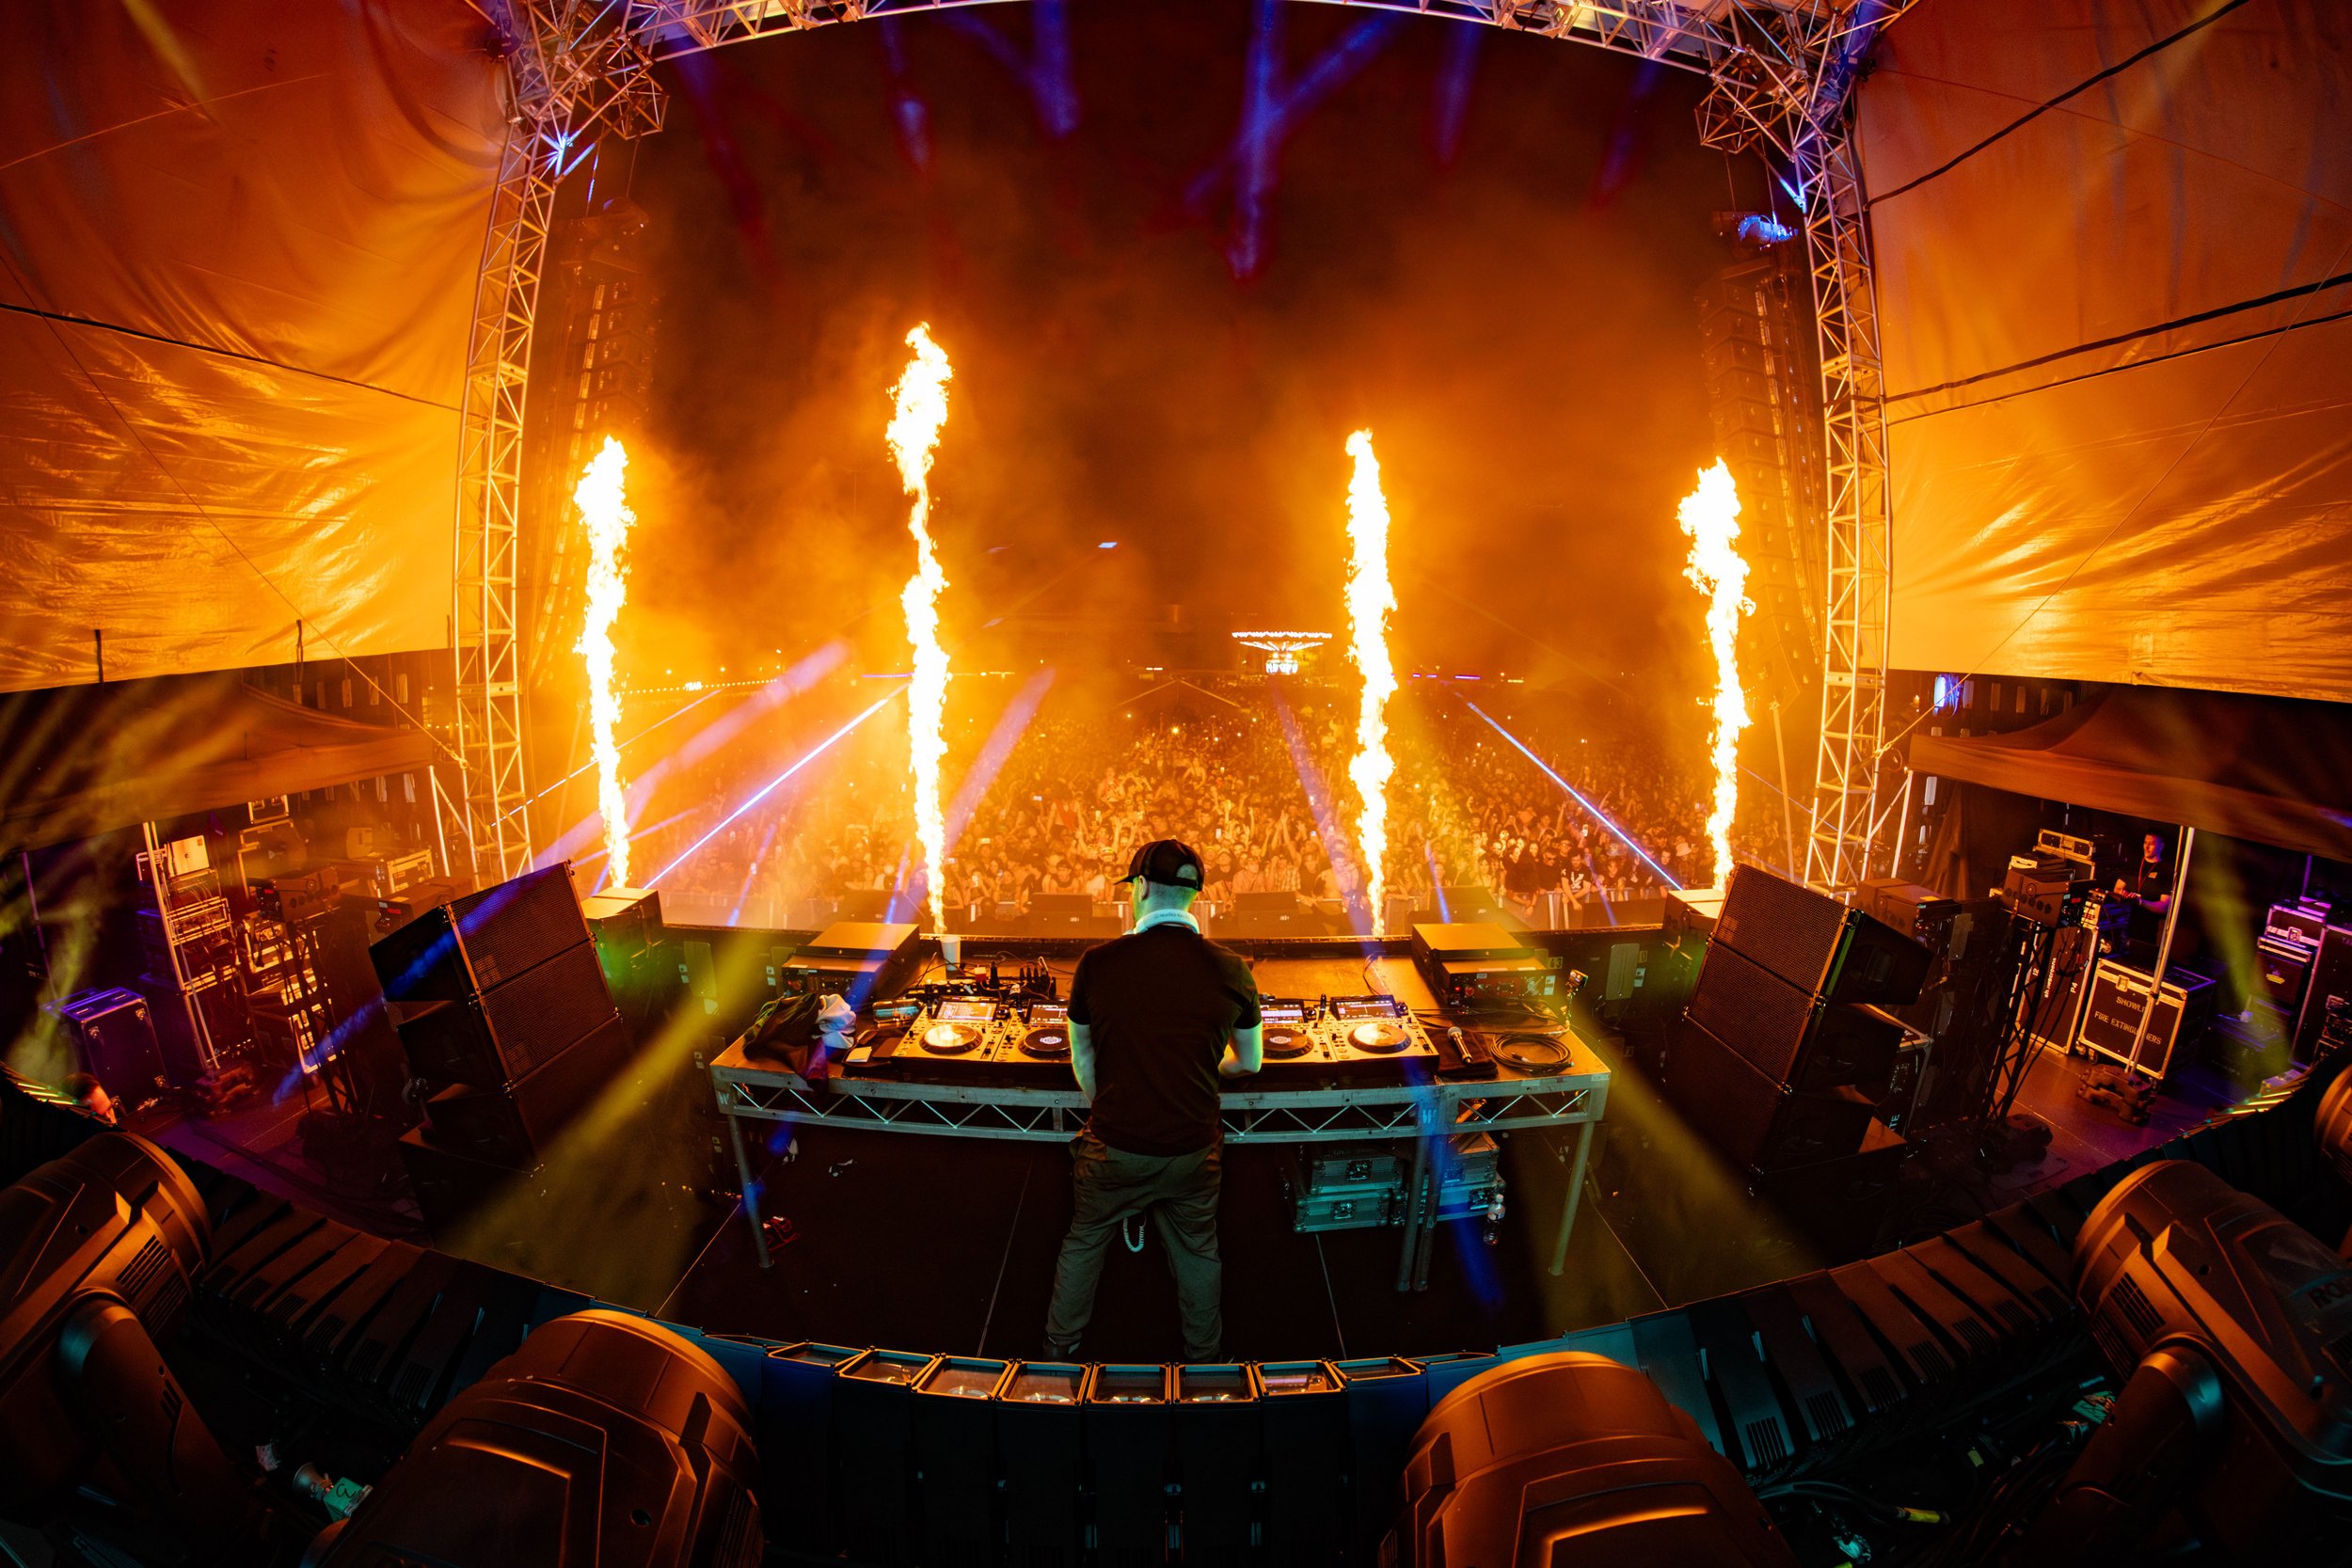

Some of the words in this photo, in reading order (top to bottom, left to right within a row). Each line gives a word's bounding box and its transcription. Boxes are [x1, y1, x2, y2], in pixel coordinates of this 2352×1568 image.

[2070, 981, 2078, 994] P4
[2094, 1010, 2109, 1023] FIRE
[2110, 1018, 2162, 1045] EXTINGUERS
